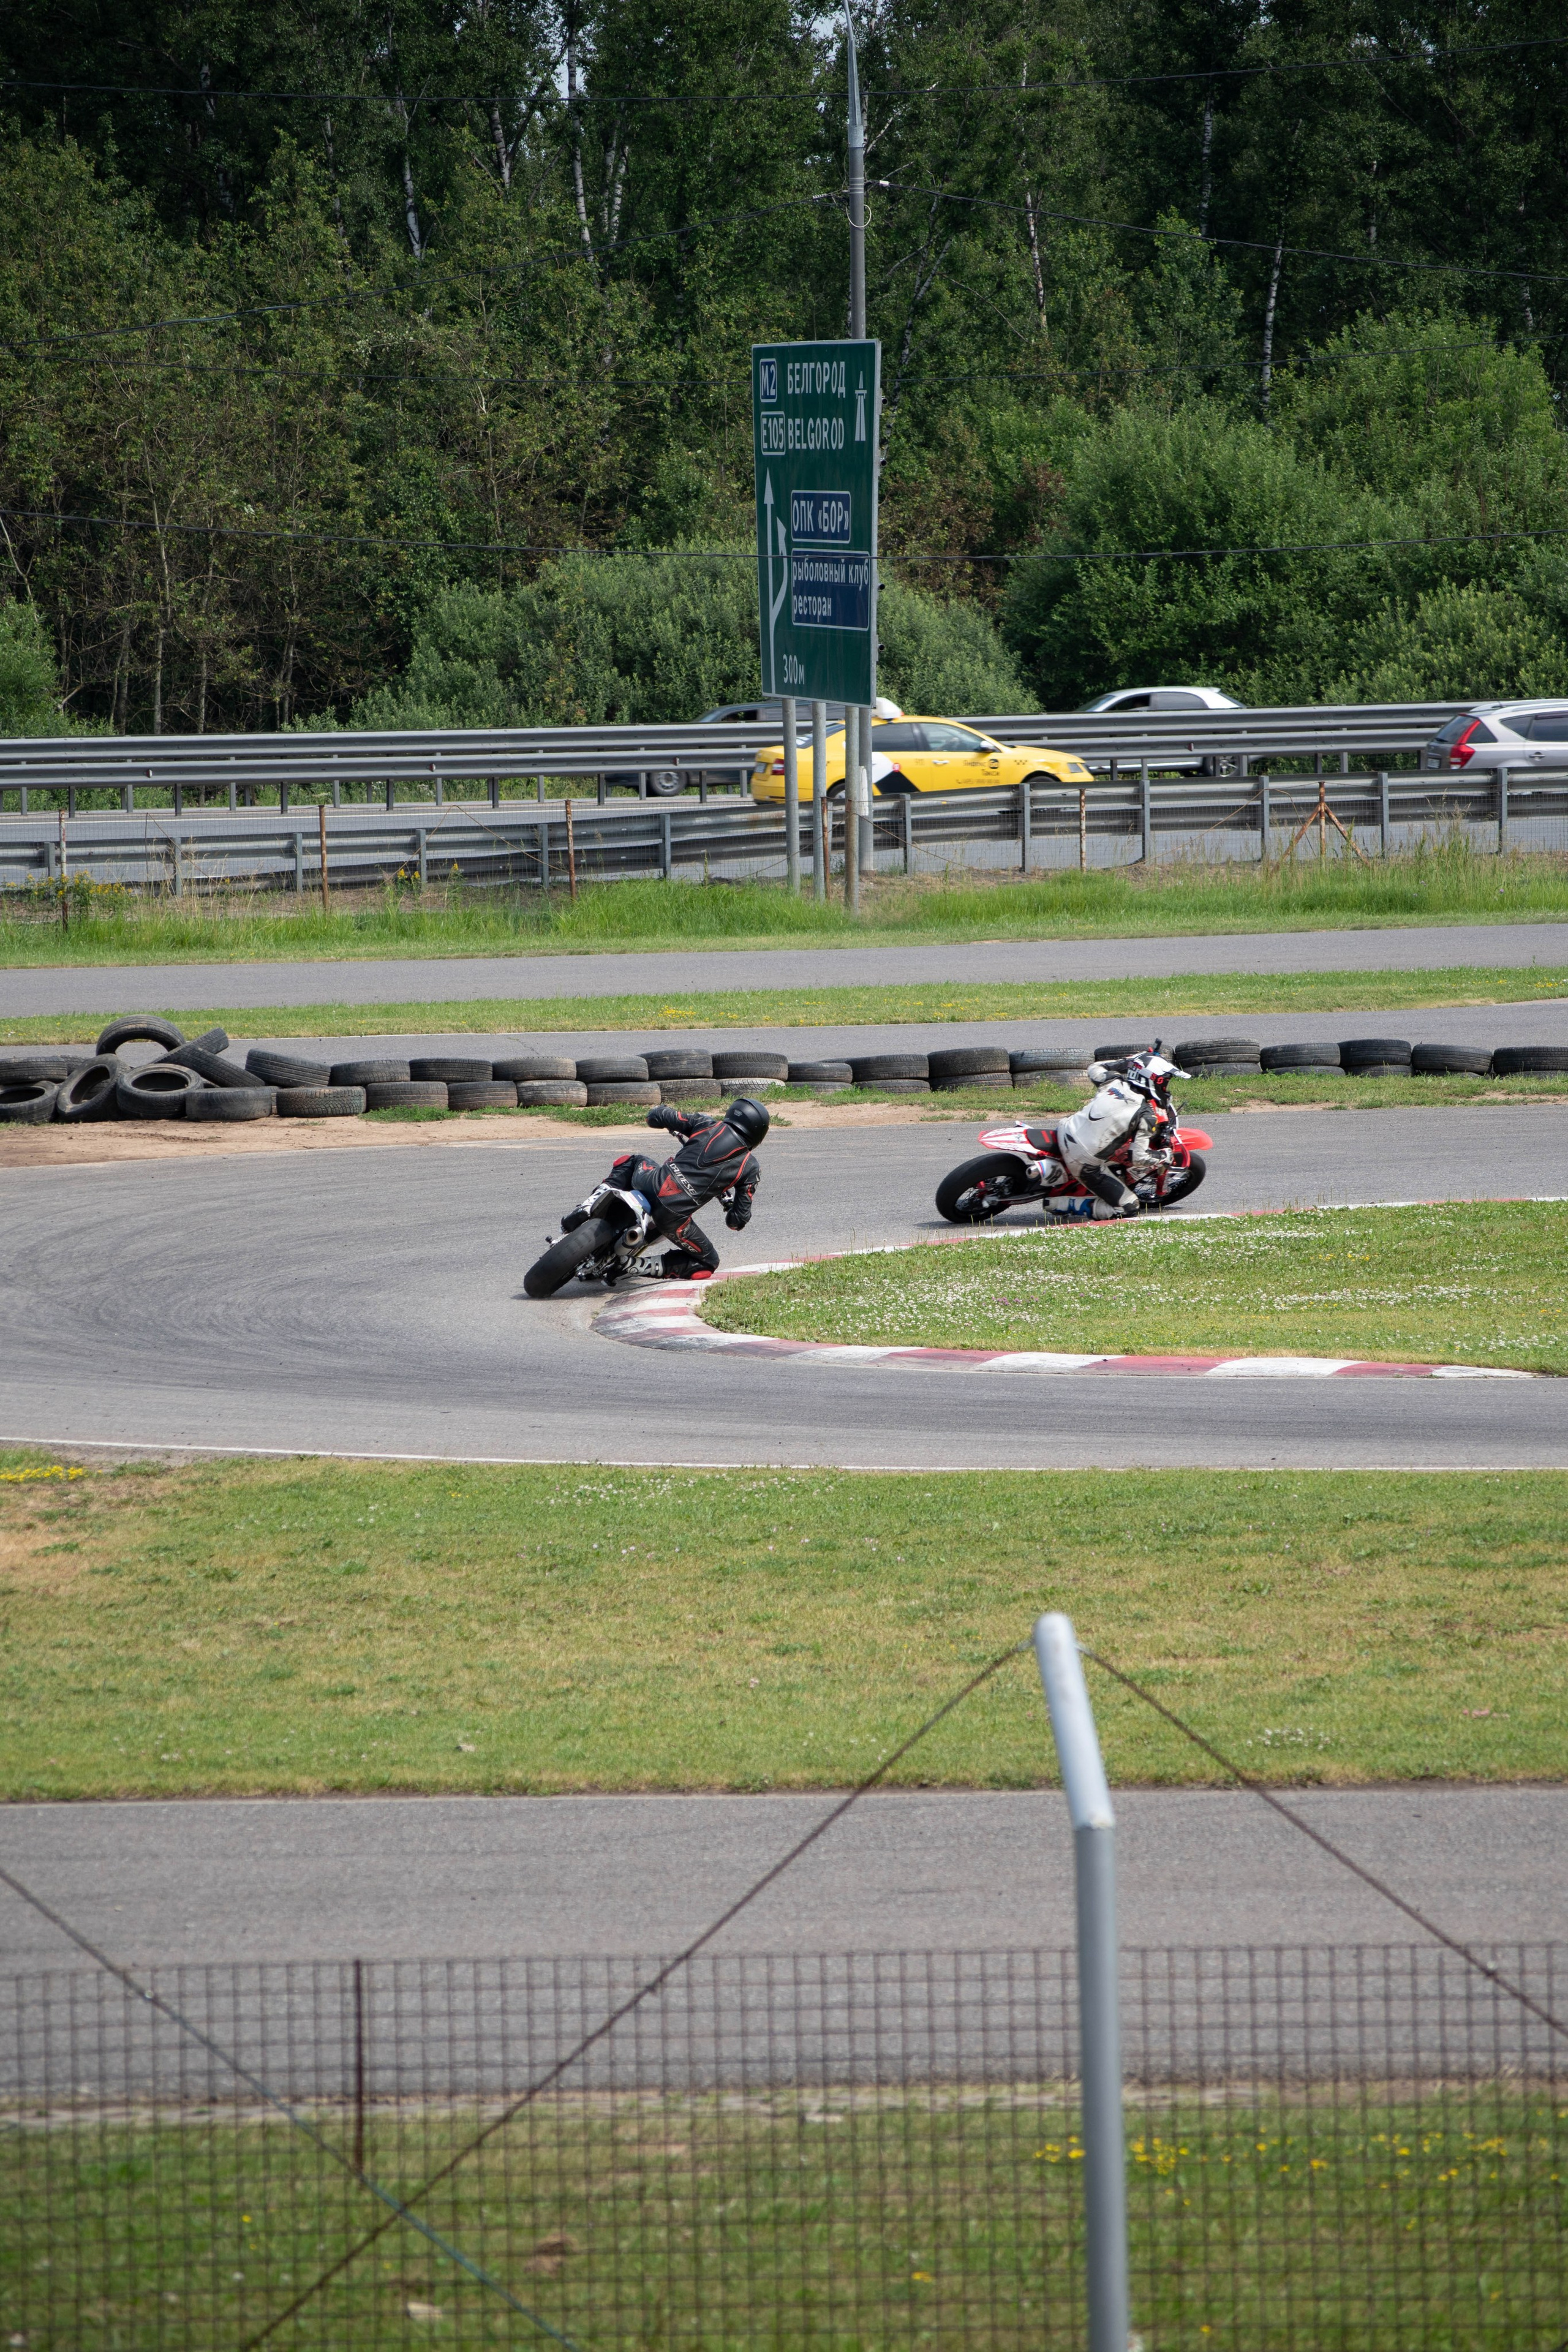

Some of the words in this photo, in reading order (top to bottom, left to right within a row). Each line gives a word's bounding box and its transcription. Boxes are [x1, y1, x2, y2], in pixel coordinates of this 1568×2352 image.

[787, 361, 846, 398] БЕЛГОРОД
[762, 417, 784, 450] E105
[788, 417, 845, 450] BELGOROD
[793, 500, 814, 532] ОПК
[818, 501, 849, 533] «БОР»
[793, 555, 845, 587] рыболовный
[849, 560, 869, 591] клуб
[793, 595, 832, 622] ресторан
[669, 1163, 697, 1196] DAINESE
[1045, 1165, 1063, 1184] 18
